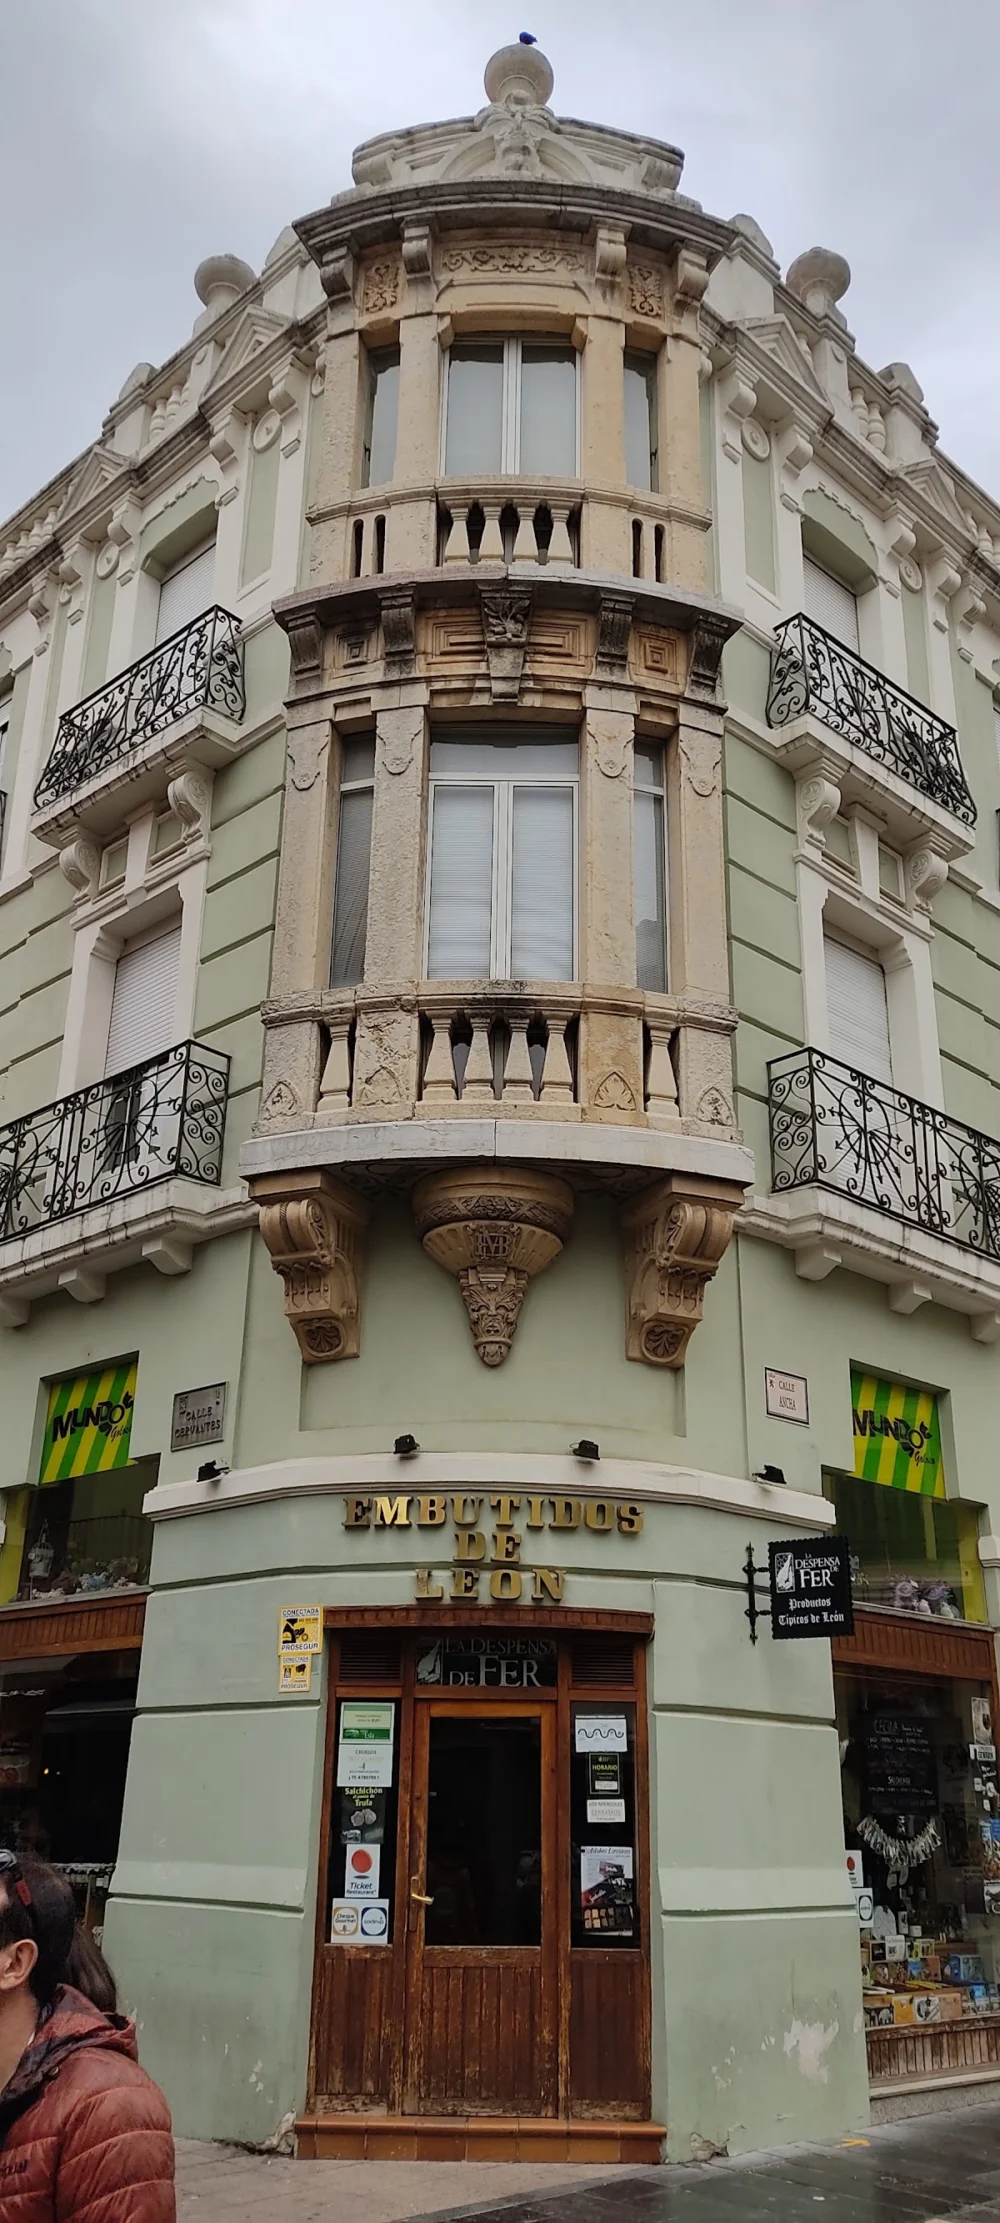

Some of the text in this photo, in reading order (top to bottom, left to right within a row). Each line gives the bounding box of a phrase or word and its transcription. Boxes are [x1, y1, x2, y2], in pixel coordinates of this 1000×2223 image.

[779, 1380, 795, 1393] CALLE
[779, 1396, 796, 1411] ANCHA
[185, 1406, 213, 1421] CALLE
[51, 1401, 126, 1443] MUNDO
[174, 1419, 221, 1439] CERVANTES
[853, 1409, 924, 1455] MUNDO
[342, 1494, 646, 1534] EMBUTIDOS
[452, 1530, 522, 1564] DE
[795, 1556, 841, 1570] DESPENSA
[829, 1565, 840, 1573] DE
[414, 1567, 567, 1601] LEON
[799, 1568, 836, 1589] FER
[282, 1607, 319, 1616] CONECTADA
[788, 1597, 831, 1611] Productos
[810, 1613, 820, 1624] de
[821, 1610, 845, 1623] León
[281, 1643, 319, 1651] PROSEGUR
[446, 1636, 558, 1656] LA DESPENSA
[449, 1654, 543, 1687] DE FER
[349, 1882, 373, 1890] Ticket
